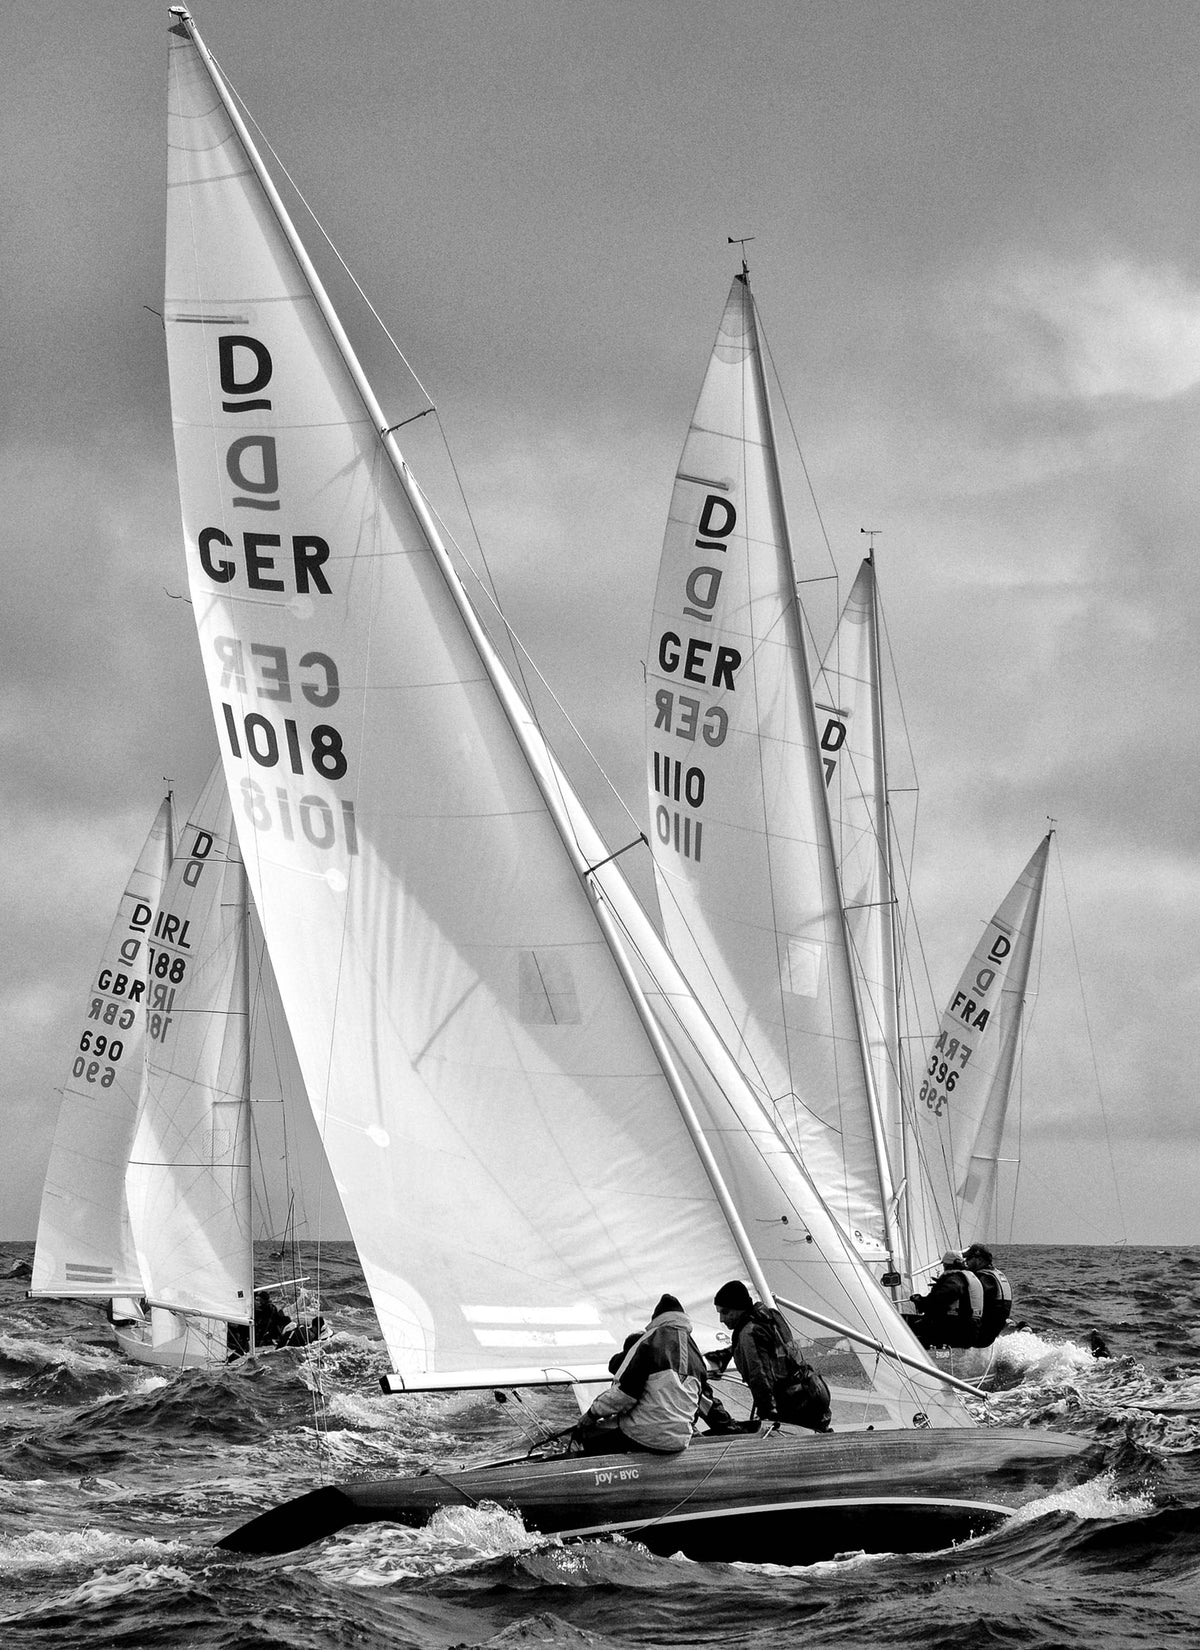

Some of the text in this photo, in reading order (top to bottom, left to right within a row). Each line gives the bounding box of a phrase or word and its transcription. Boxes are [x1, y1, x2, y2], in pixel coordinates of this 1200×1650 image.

[218, 335, 273, 395] D
[698, 495, 737, 538] D
[197, 526, 333, 594] GER
[658, 631, 742, 691] GER
[222, 702, 348, 780] 1018
[821, 719, 847, 752] D
[653, 751, 706, 808] 1110
[190, 831, 213, 859] D
[131, 903, 151, 926] D
[154, 911, 191, 949] IRL
[990, 935, 1011, 958] D
[148, 947, 186, 984] 188
[98, 969, 146, 1003] GBR
[950, 991, 990, 1032] FRA
[79, 1030, 124, 1062] 690
[927, 1055, 960, 1092] 396
[619, 1469, 640, 1480] BYC
